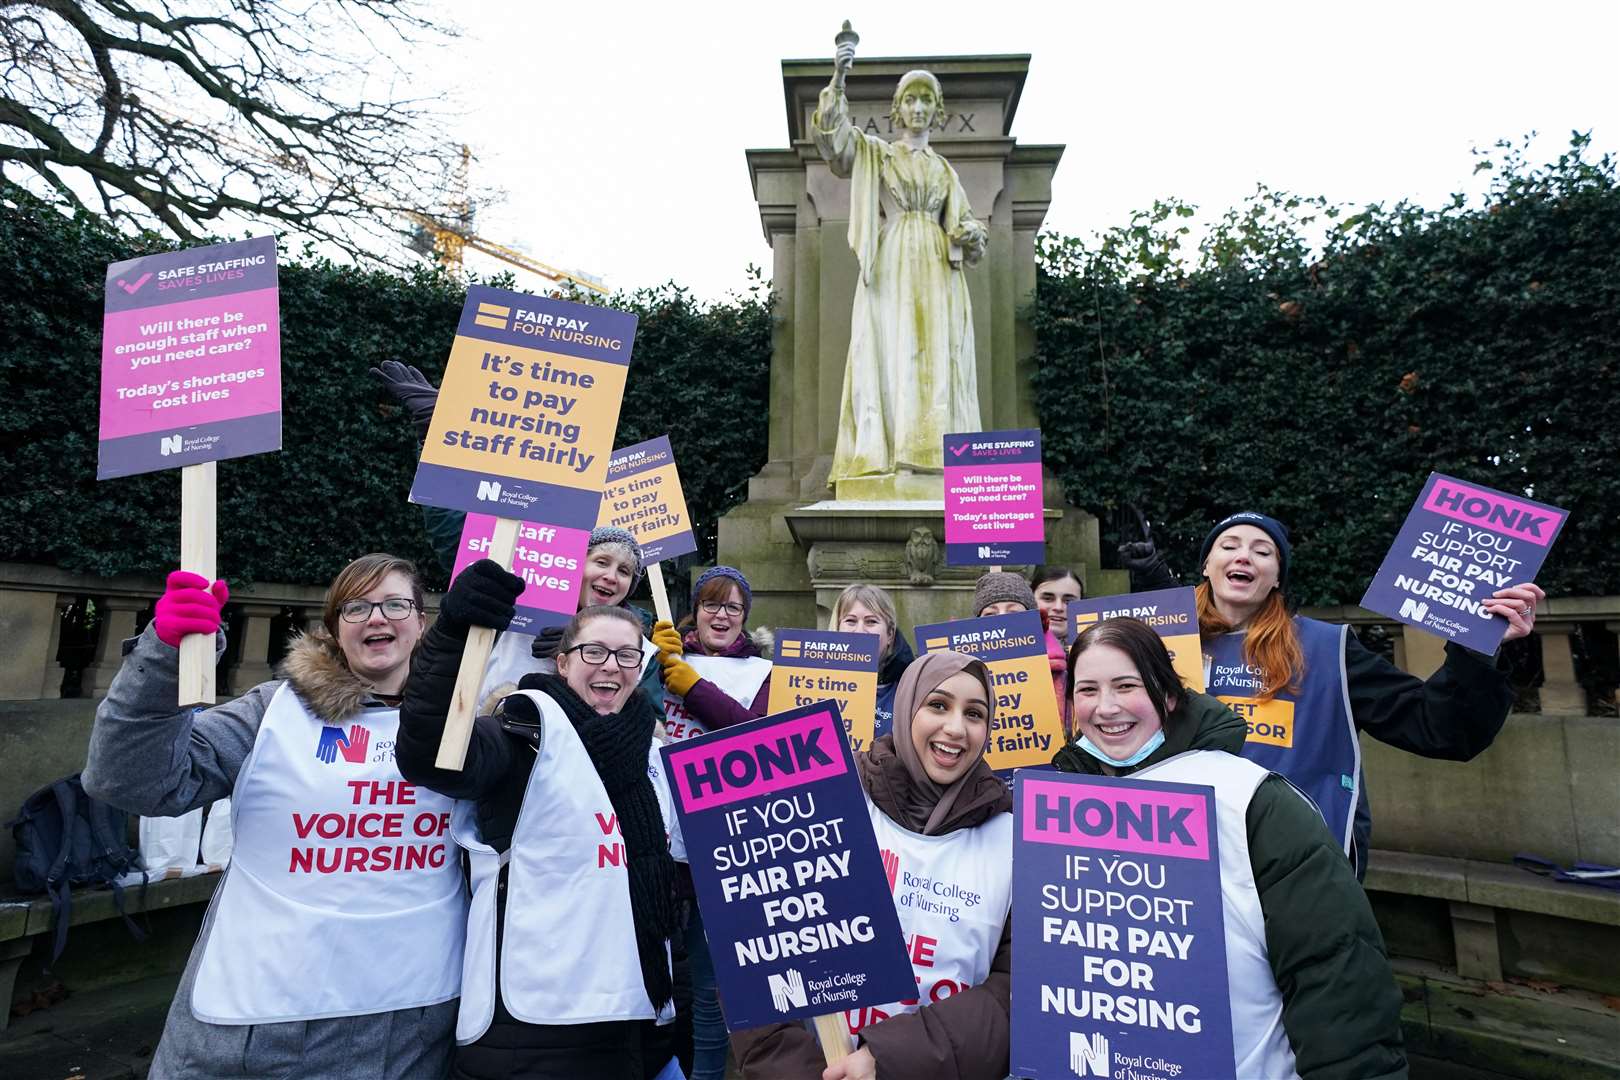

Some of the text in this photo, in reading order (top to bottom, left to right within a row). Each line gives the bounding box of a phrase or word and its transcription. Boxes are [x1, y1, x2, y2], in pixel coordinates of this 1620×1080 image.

[158, 255, 266, 280] SAFE STAFFING
[158, 269, 244, 290] SAVES LIVES
[140, 311, 244, 336] Will there be
[516, 308, 589, 331] FAIR PAY
[115, 323, 268, 355] enough staff when
[512, 321, 622, 351] FOR NURSING
[131, 339, 252, 369] you need care?
[480, 352, 595, 389] It's time
[117, 367, 265, 400] Today's shortages
[153, 388, 229, 409] cost lives
[489, 381, 576, 416] to pay
[470, 406, 581, 444] nursing
[442, 429, 594, 474] staff fairly
[972, 442, 993, 450] SAFE
[608, 451, 646, 468] FAIR PAY
[609, 451, 667, 474] FOR NURSING
[628, 475, 662, 492] time
[951, 486, 985, 494] enough
[986, 484, 1008, 492] staff
[963, 476, 982, 484] Will
[613, 491, 658, 511] to pay
[960, 496, 976, 504] you
[611, 503, 667, 526] nursing
[642, 514, 680, 532] fairly
[953, 512, 1034, 522] Today's shortages
[1434, 488, 1550, 537] HONK
[519, 524, 556, 543] taff
[972, 521, 1015, 530] cost lives
[1442, 521, 1512, 552] IF YOU
[1419, 531, 1522, 574] SUPPORT
[1412, 546, 1512, 588] FAIR PAY
[522, 568, 570, 591] lives
[1428, 569, 1475, 595] FOR
[1133, 606, 1158, 617] PAY
[1427, 612, 1446, 626] Royal
[1445, 619, 1470, 633] College
[953, 628, 1006, 645] FAIR PAY
[1424, 619, 1457, 637] of Nursing
[804, 641, 850, 652] FAIR PAY
[955, 635, 1036, 653] FOR NURSING
[804, 650, 872, 662] FOR NURSING
[990, 670, 1028, 686] ime
[1214, 677, 1225, 687] of
[1216, 664, 1244, 677] Royal
[789, 675, 858, 692] It's time
[995, 692, 1022, 710] ay
[996, 732, 1052, 753] fairly
[685, 727, 833, 799] HONK
[348, 781, 416, 805] THE
[725, 792, 816, 836] IF YOU
[1035, 794, 1198, 846] HONK
[292, 813, 404, 839] VOICE
[713, 818, 844, 871] SUPPORT
[289, 844, 445, 873] NURSING
[721, 850, 851, 902] FAIR PAY
[1065, 854, 1166, 889] IF YOU
[901, 893, 915, 907] of
[933, 881, 981, 907] College
[1041, 884, 1194, 926] SUPPORT
[763, 892, 828, 927] FOR
[734, 915, 875, 967] NURSING
[1043, 917, 1194, 960] FAIR PAY
[808, 976, 834, 992] Royal
[836, 972, 867, 986] College
[1084, 955, 1154, 991] FOR
[812, 987, 858, 1004] of Nursing
[1041, 984, 1201, 1033] NURSING
[1114, 1052, 1142, 1069] Royal
[1144, 1058, 1181, 1076] College
[1115, 1068, 1125, 1080] of
